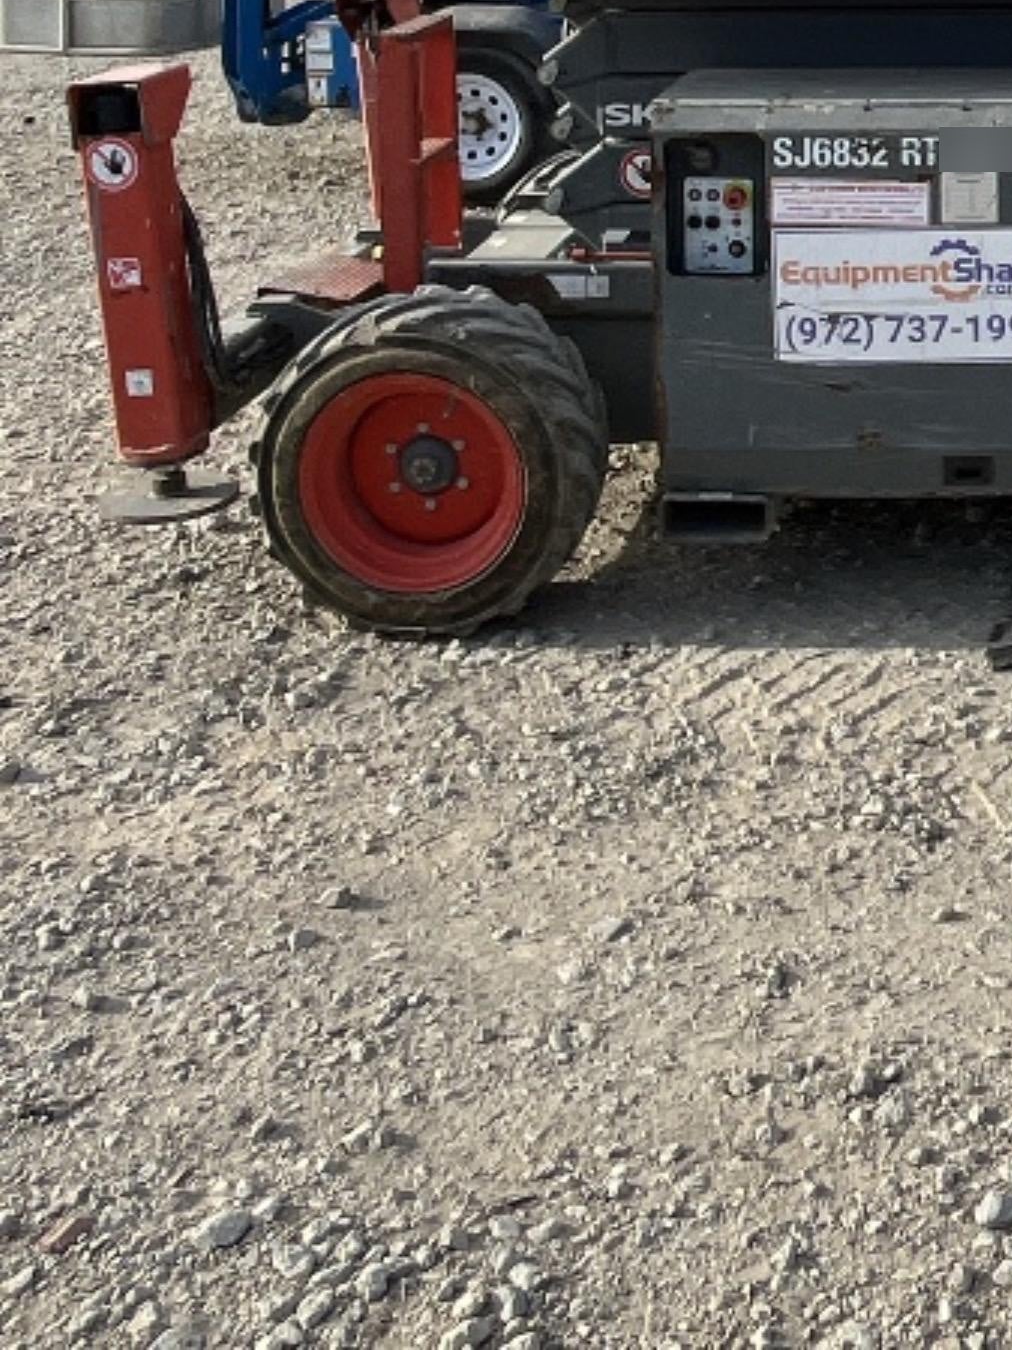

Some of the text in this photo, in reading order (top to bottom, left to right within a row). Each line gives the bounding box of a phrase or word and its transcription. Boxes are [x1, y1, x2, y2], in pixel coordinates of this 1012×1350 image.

[773, 136, 889, 167] SJ6832
[901, 137, 940, 166] RT
[786, 313, 875, 351] (972)
